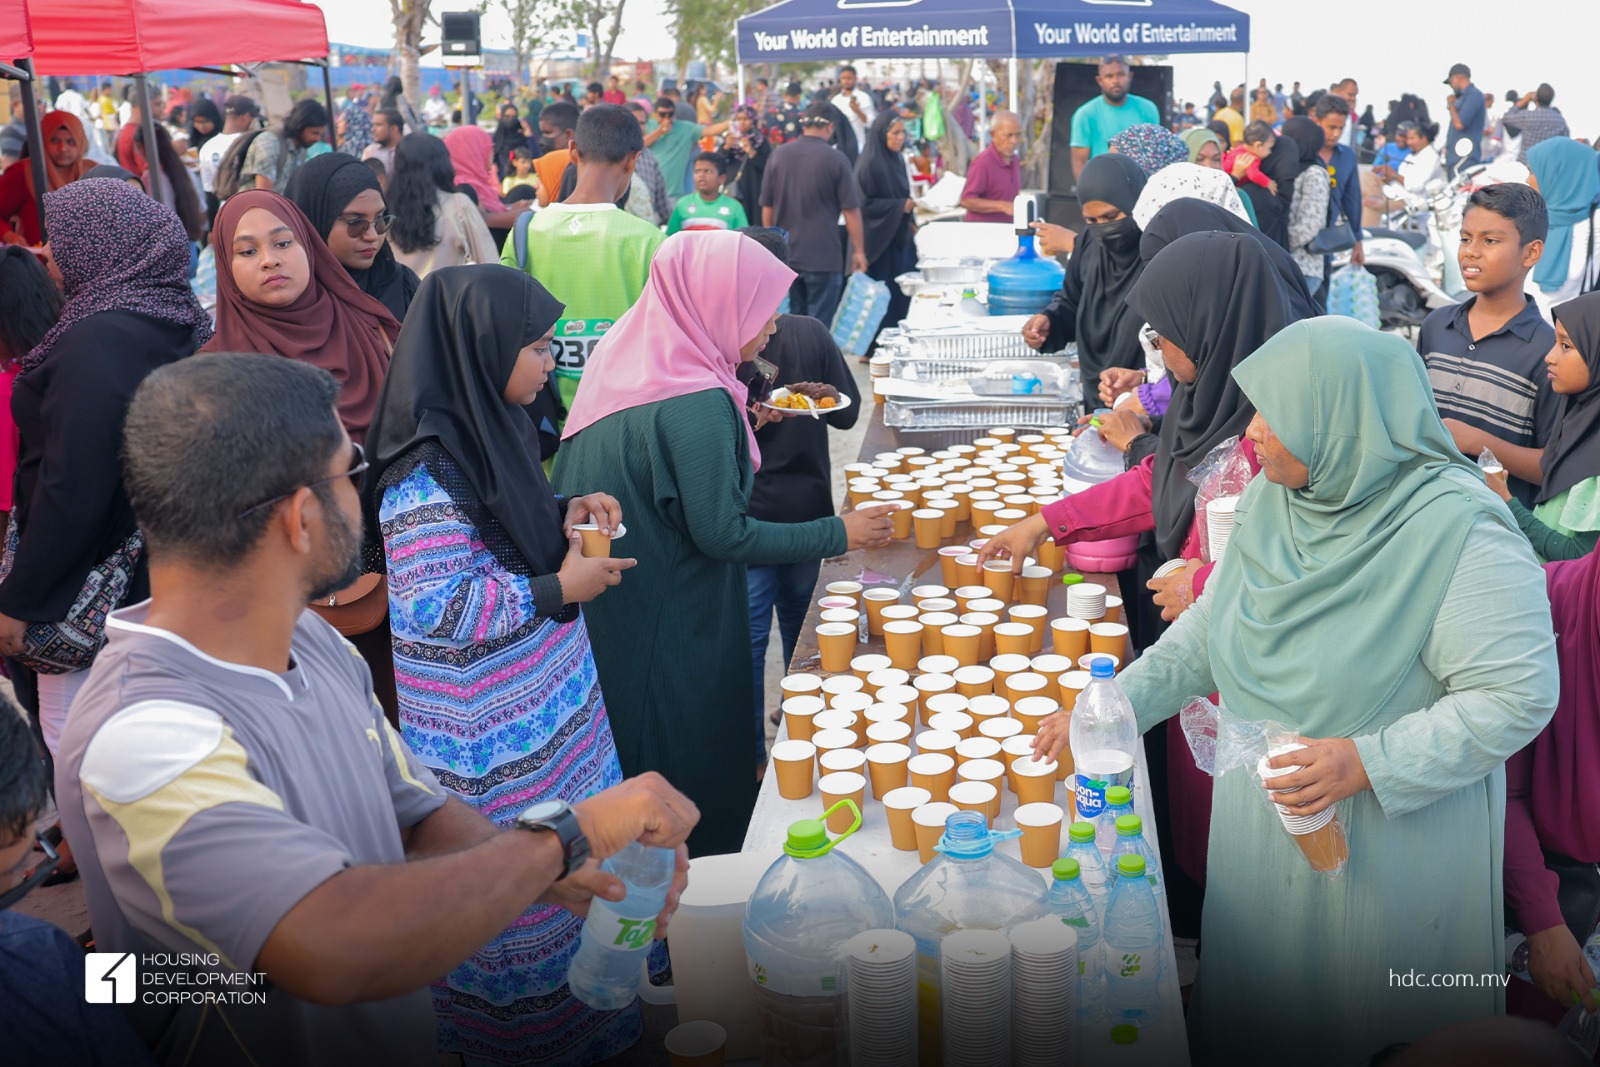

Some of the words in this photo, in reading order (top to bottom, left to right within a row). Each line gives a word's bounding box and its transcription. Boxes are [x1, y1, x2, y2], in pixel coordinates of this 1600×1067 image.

[754, 31, 789, 51] Your
[790, 28, 837, 49] World
[840, 26, 859, 47] of
[861, 24, 989, 47] Entertainment
[1033, 23, 1072, 44] Your
[1074, 23, 1120, 44] World
[1122, 23, 1140, 43] of
[1142, 23, 1238, 43] Entertainment
